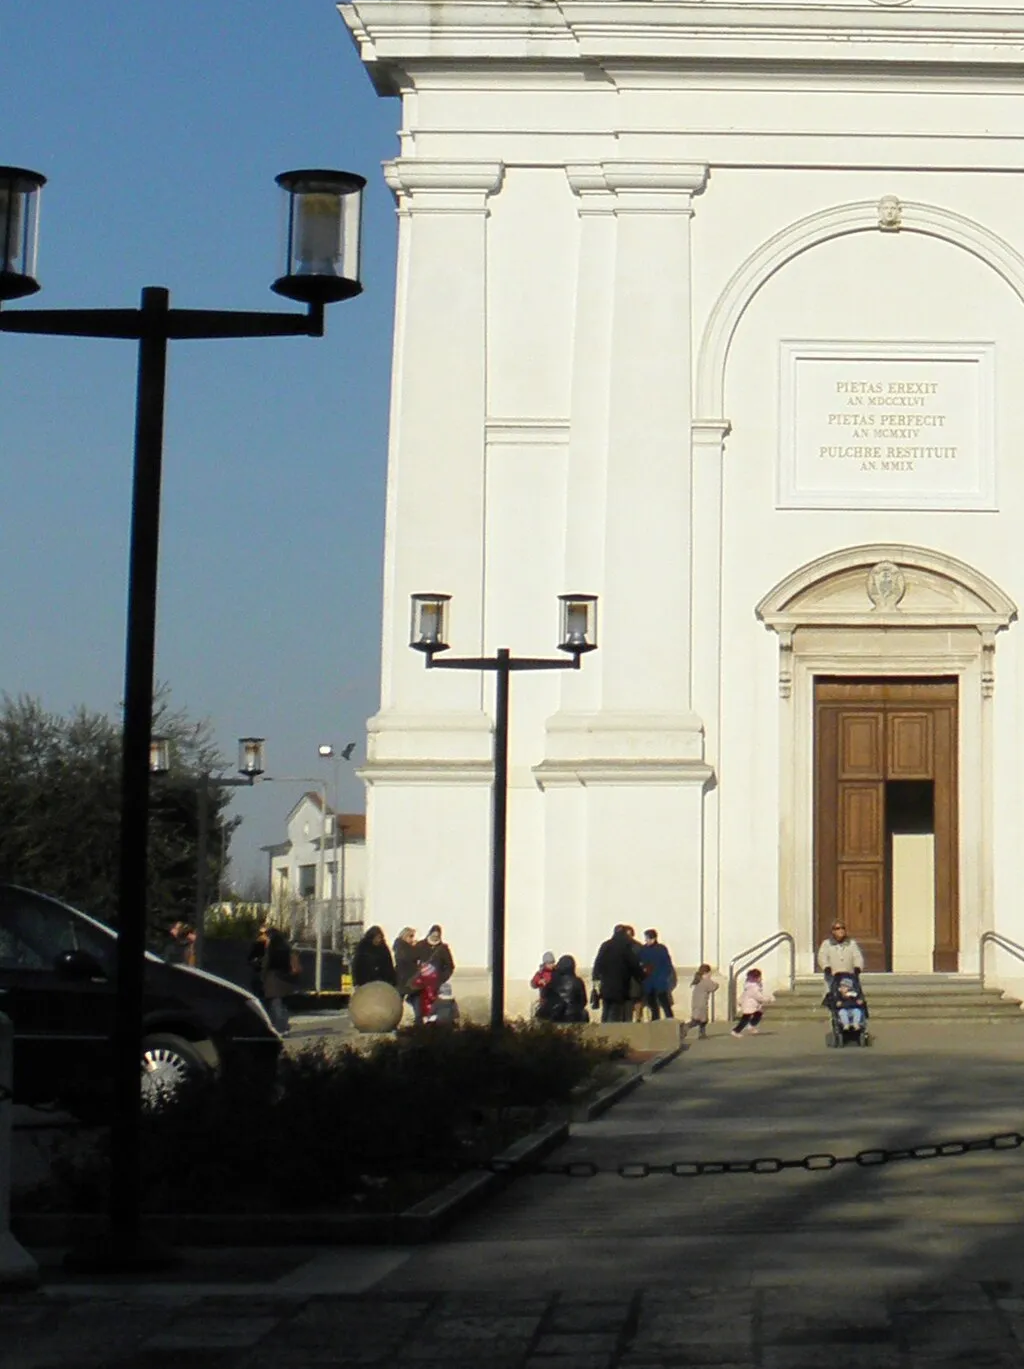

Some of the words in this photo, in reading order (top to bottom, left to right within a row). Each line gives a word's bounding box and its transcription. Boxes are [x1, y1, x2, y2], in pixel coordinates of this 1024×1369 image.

[836, 382, 884, 394] PIETAS
[887, 382, 939, 394] EREXIT
[827, 414, 875, 425] PIETAS
[880, 414, 946, 426] PERFECIT
[819, 446, 882, 458] PULCHRE
[886, 447, 958, 459] RESTITUIT
[880, 461, 914, 471] MMIX
